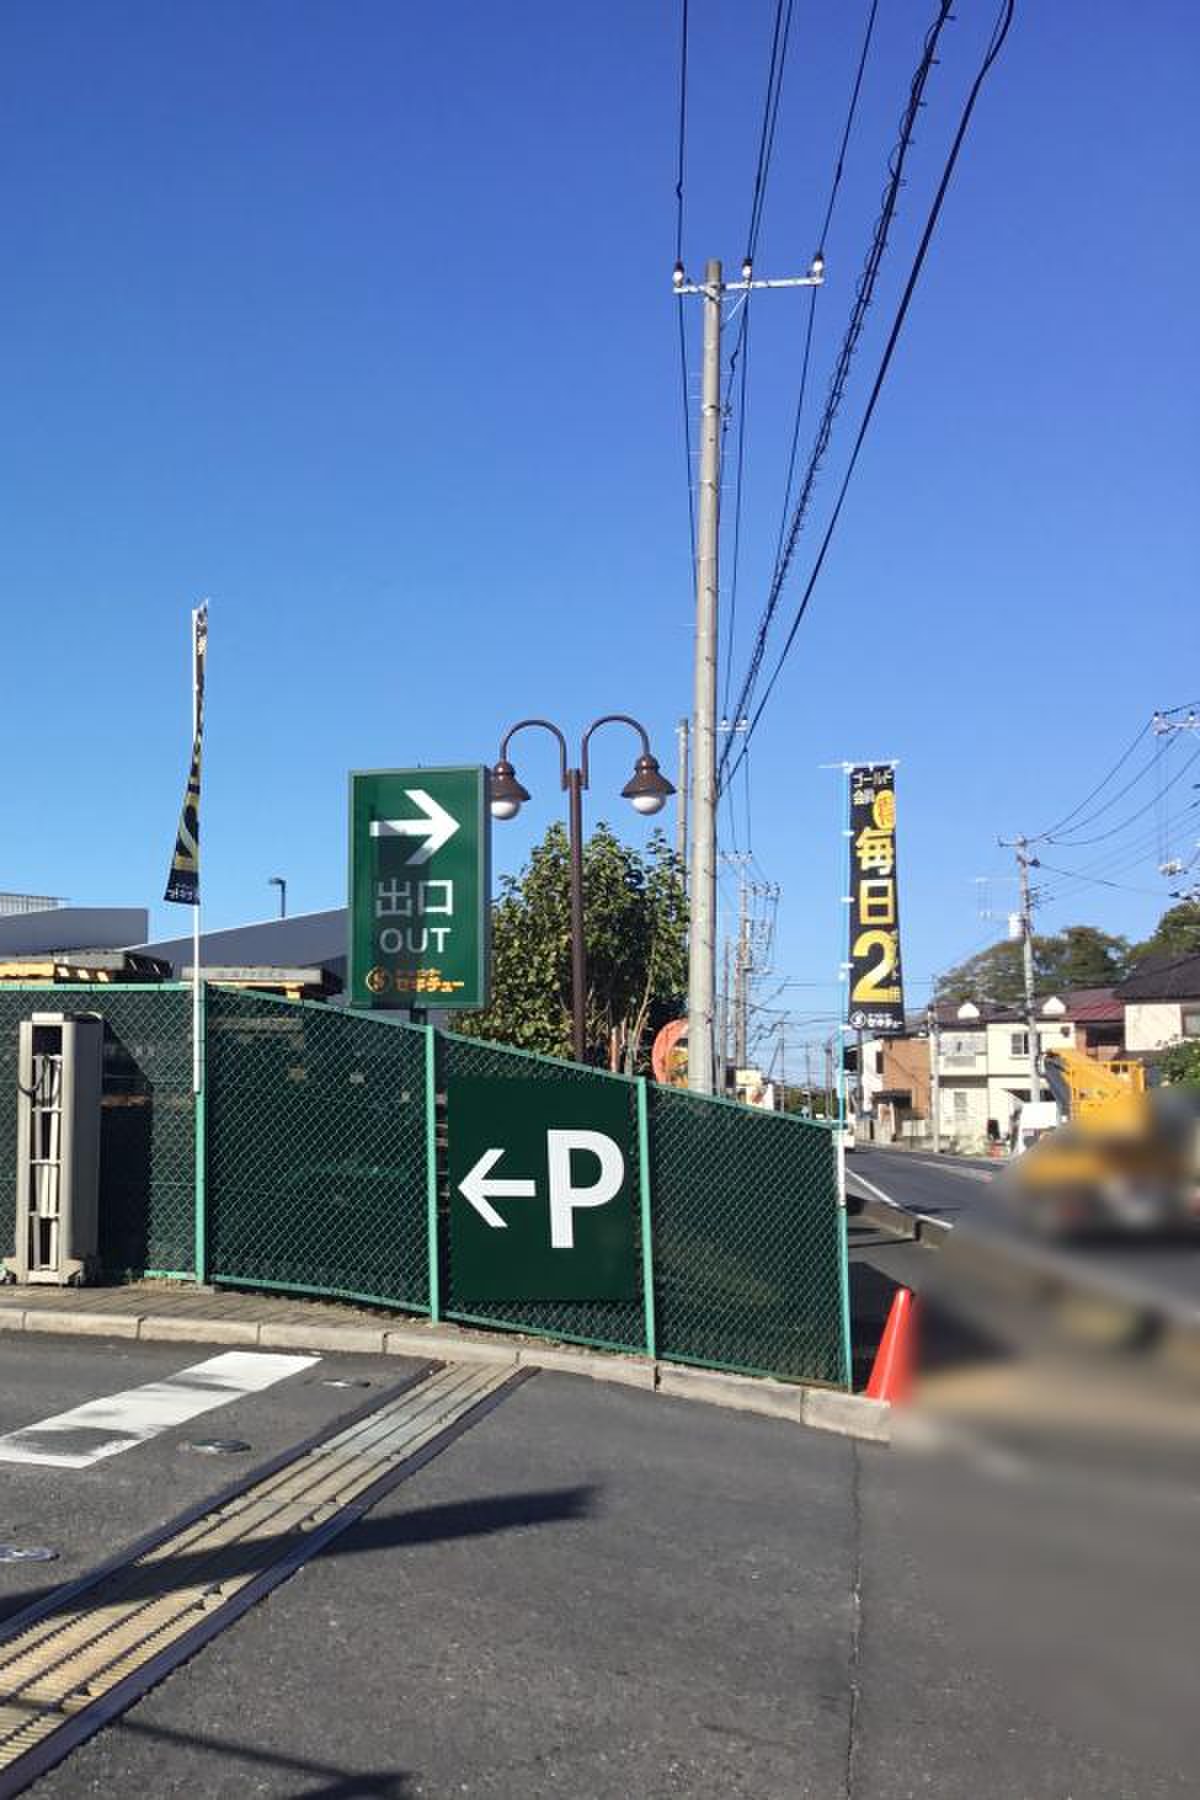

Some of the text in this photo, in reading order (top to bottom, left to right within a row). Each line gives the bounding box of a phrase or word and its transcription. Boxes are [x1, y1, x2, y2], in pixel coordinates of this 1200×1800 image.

[375, 877, 453, 917] 出口
[379, 927, 451, 954] OUT
[547, 1129, 625, 1249] P
